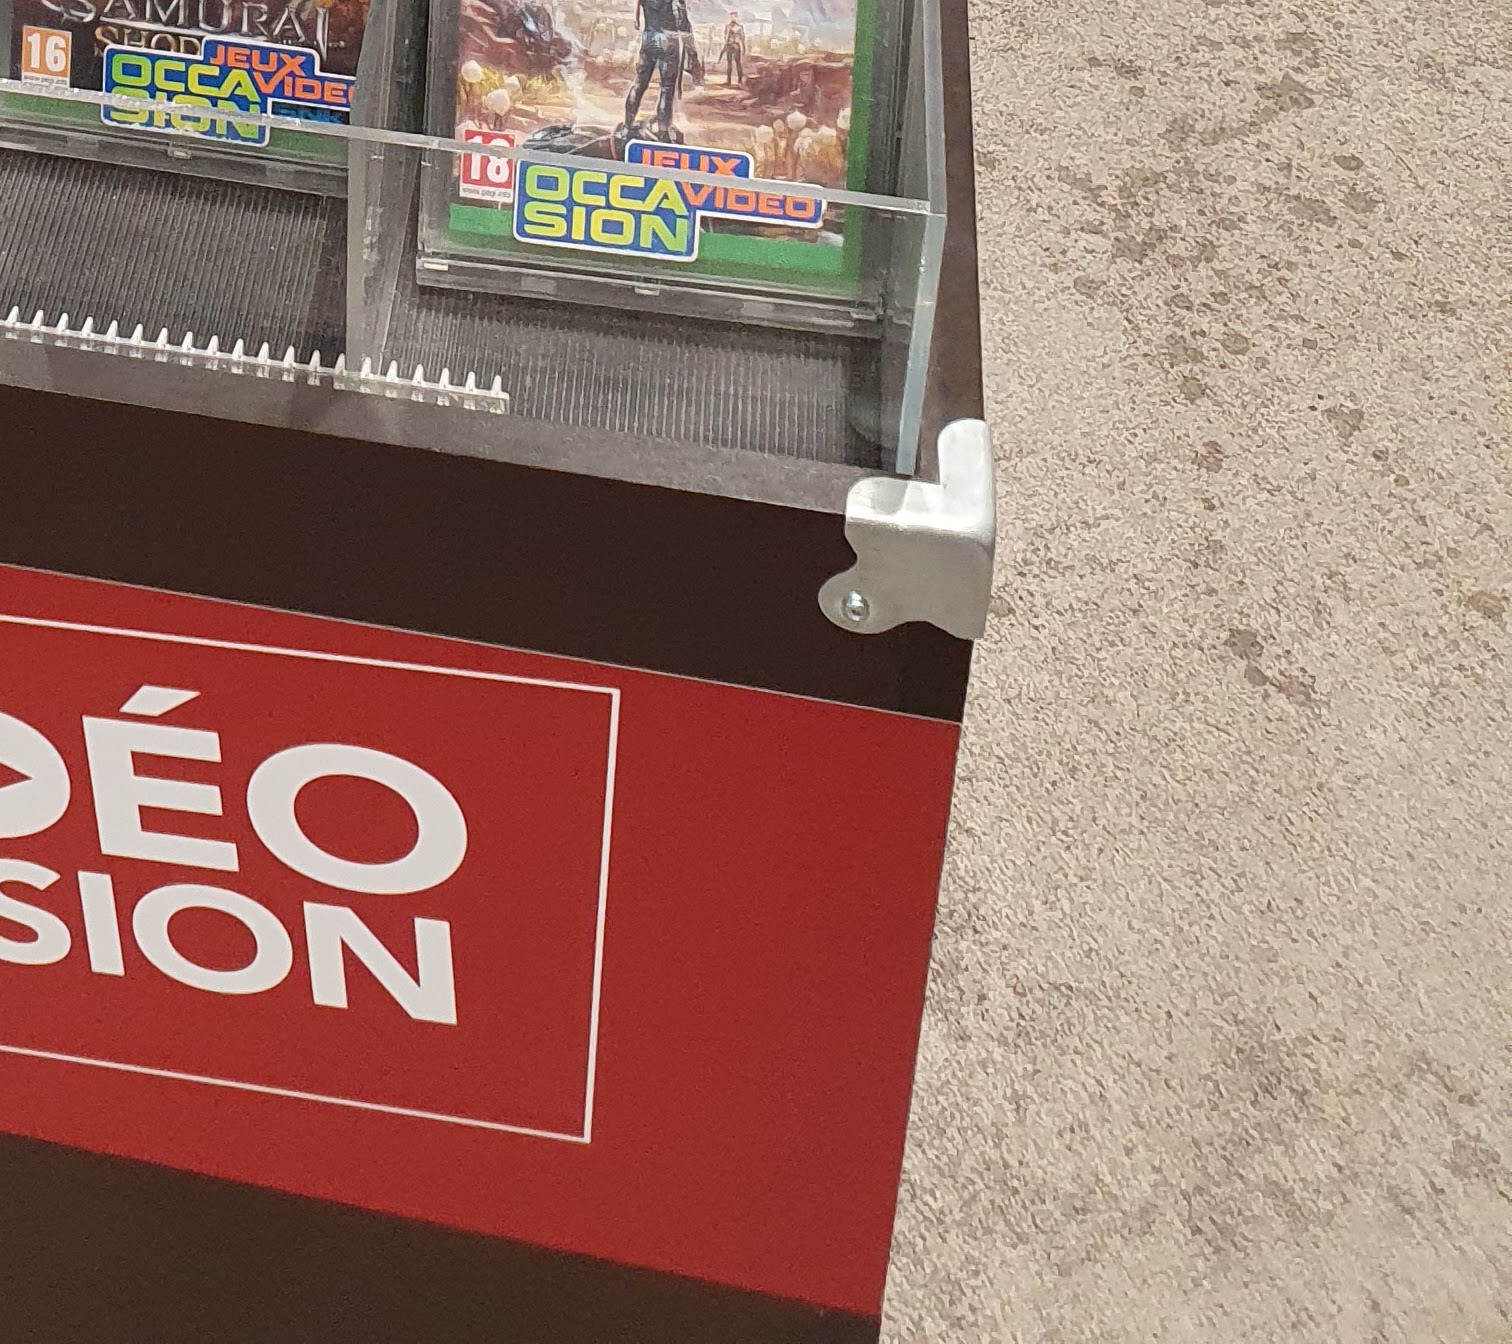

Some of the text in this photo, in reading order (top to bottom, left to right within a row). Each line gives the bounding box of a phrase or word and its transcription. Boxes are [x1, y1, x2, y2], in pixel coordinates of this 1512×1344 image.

[27, 32, 67, 72] 16
[94, 23, 202, 57] SHOD
[209, 44, 307, 77] JEUX
[111, 53, 354, 104] OCCA VIDE
[110, 85, 260, 139] SION
[466, 135, 510, 184] 18
[639, 149, 742, 177] JEUX
[525, 163, 817, 219] OCCA VIDEO
[523, 201, 689, 254] SION
